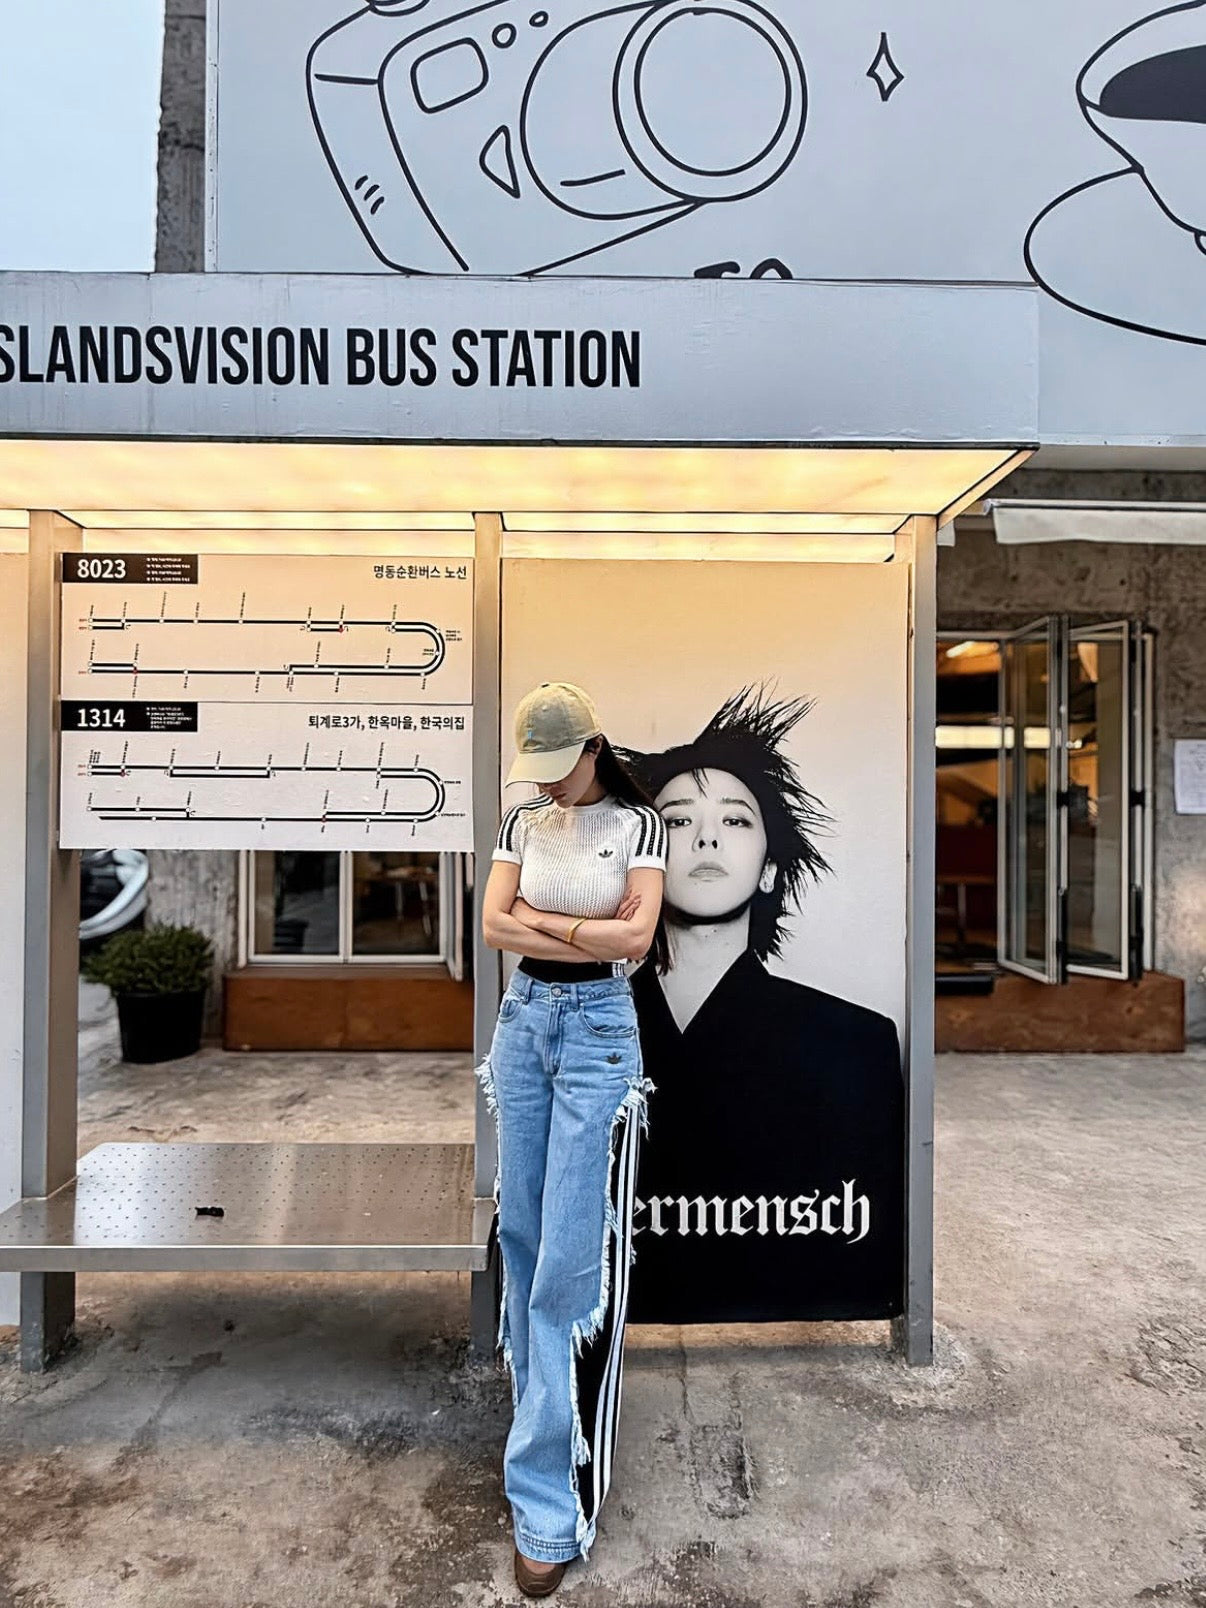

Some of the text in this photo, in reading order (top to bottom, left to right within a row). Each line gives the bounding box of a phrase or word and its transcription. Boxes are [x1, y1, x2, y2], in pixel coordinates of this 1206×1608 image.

[347, 328, 437, 387] BUS
[452, 329, 640, 388] STATION
[77, 558, 126, 580] 8023
[373, 564, 467, 580] 명동순환버스 노선
[77, 707, 126, 728] 1314
[308, 715, 465, 731] 퇴계로3가, 한옥마을, 한국의집
